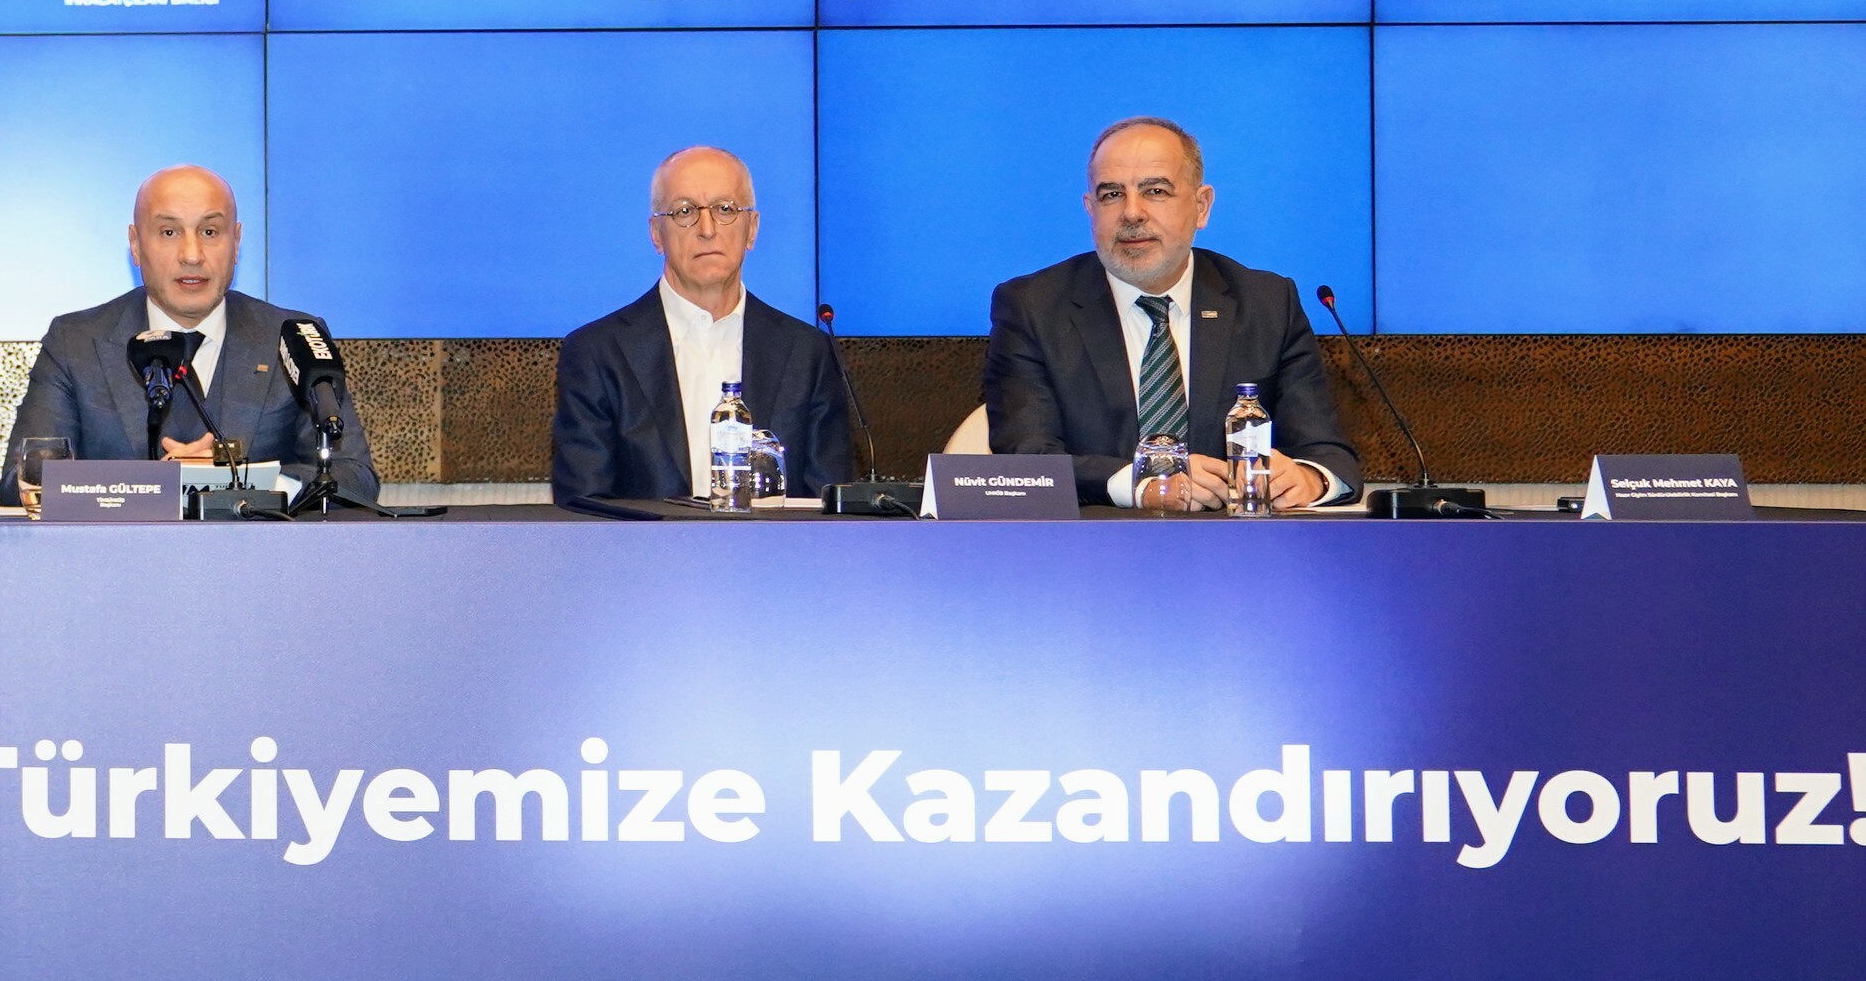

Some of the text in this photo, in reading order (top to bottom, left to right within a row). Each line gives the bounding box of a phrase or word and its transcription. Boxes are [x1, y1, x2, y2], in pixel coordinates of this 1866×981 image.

[954, 476, 1054, 487] Nüvit GÜNDEMİR
[1610, 478, 1738, 490] Selçuk Mehmet KAYA
[61, 482, 162, 494] Mustafa GÜLTEPE
